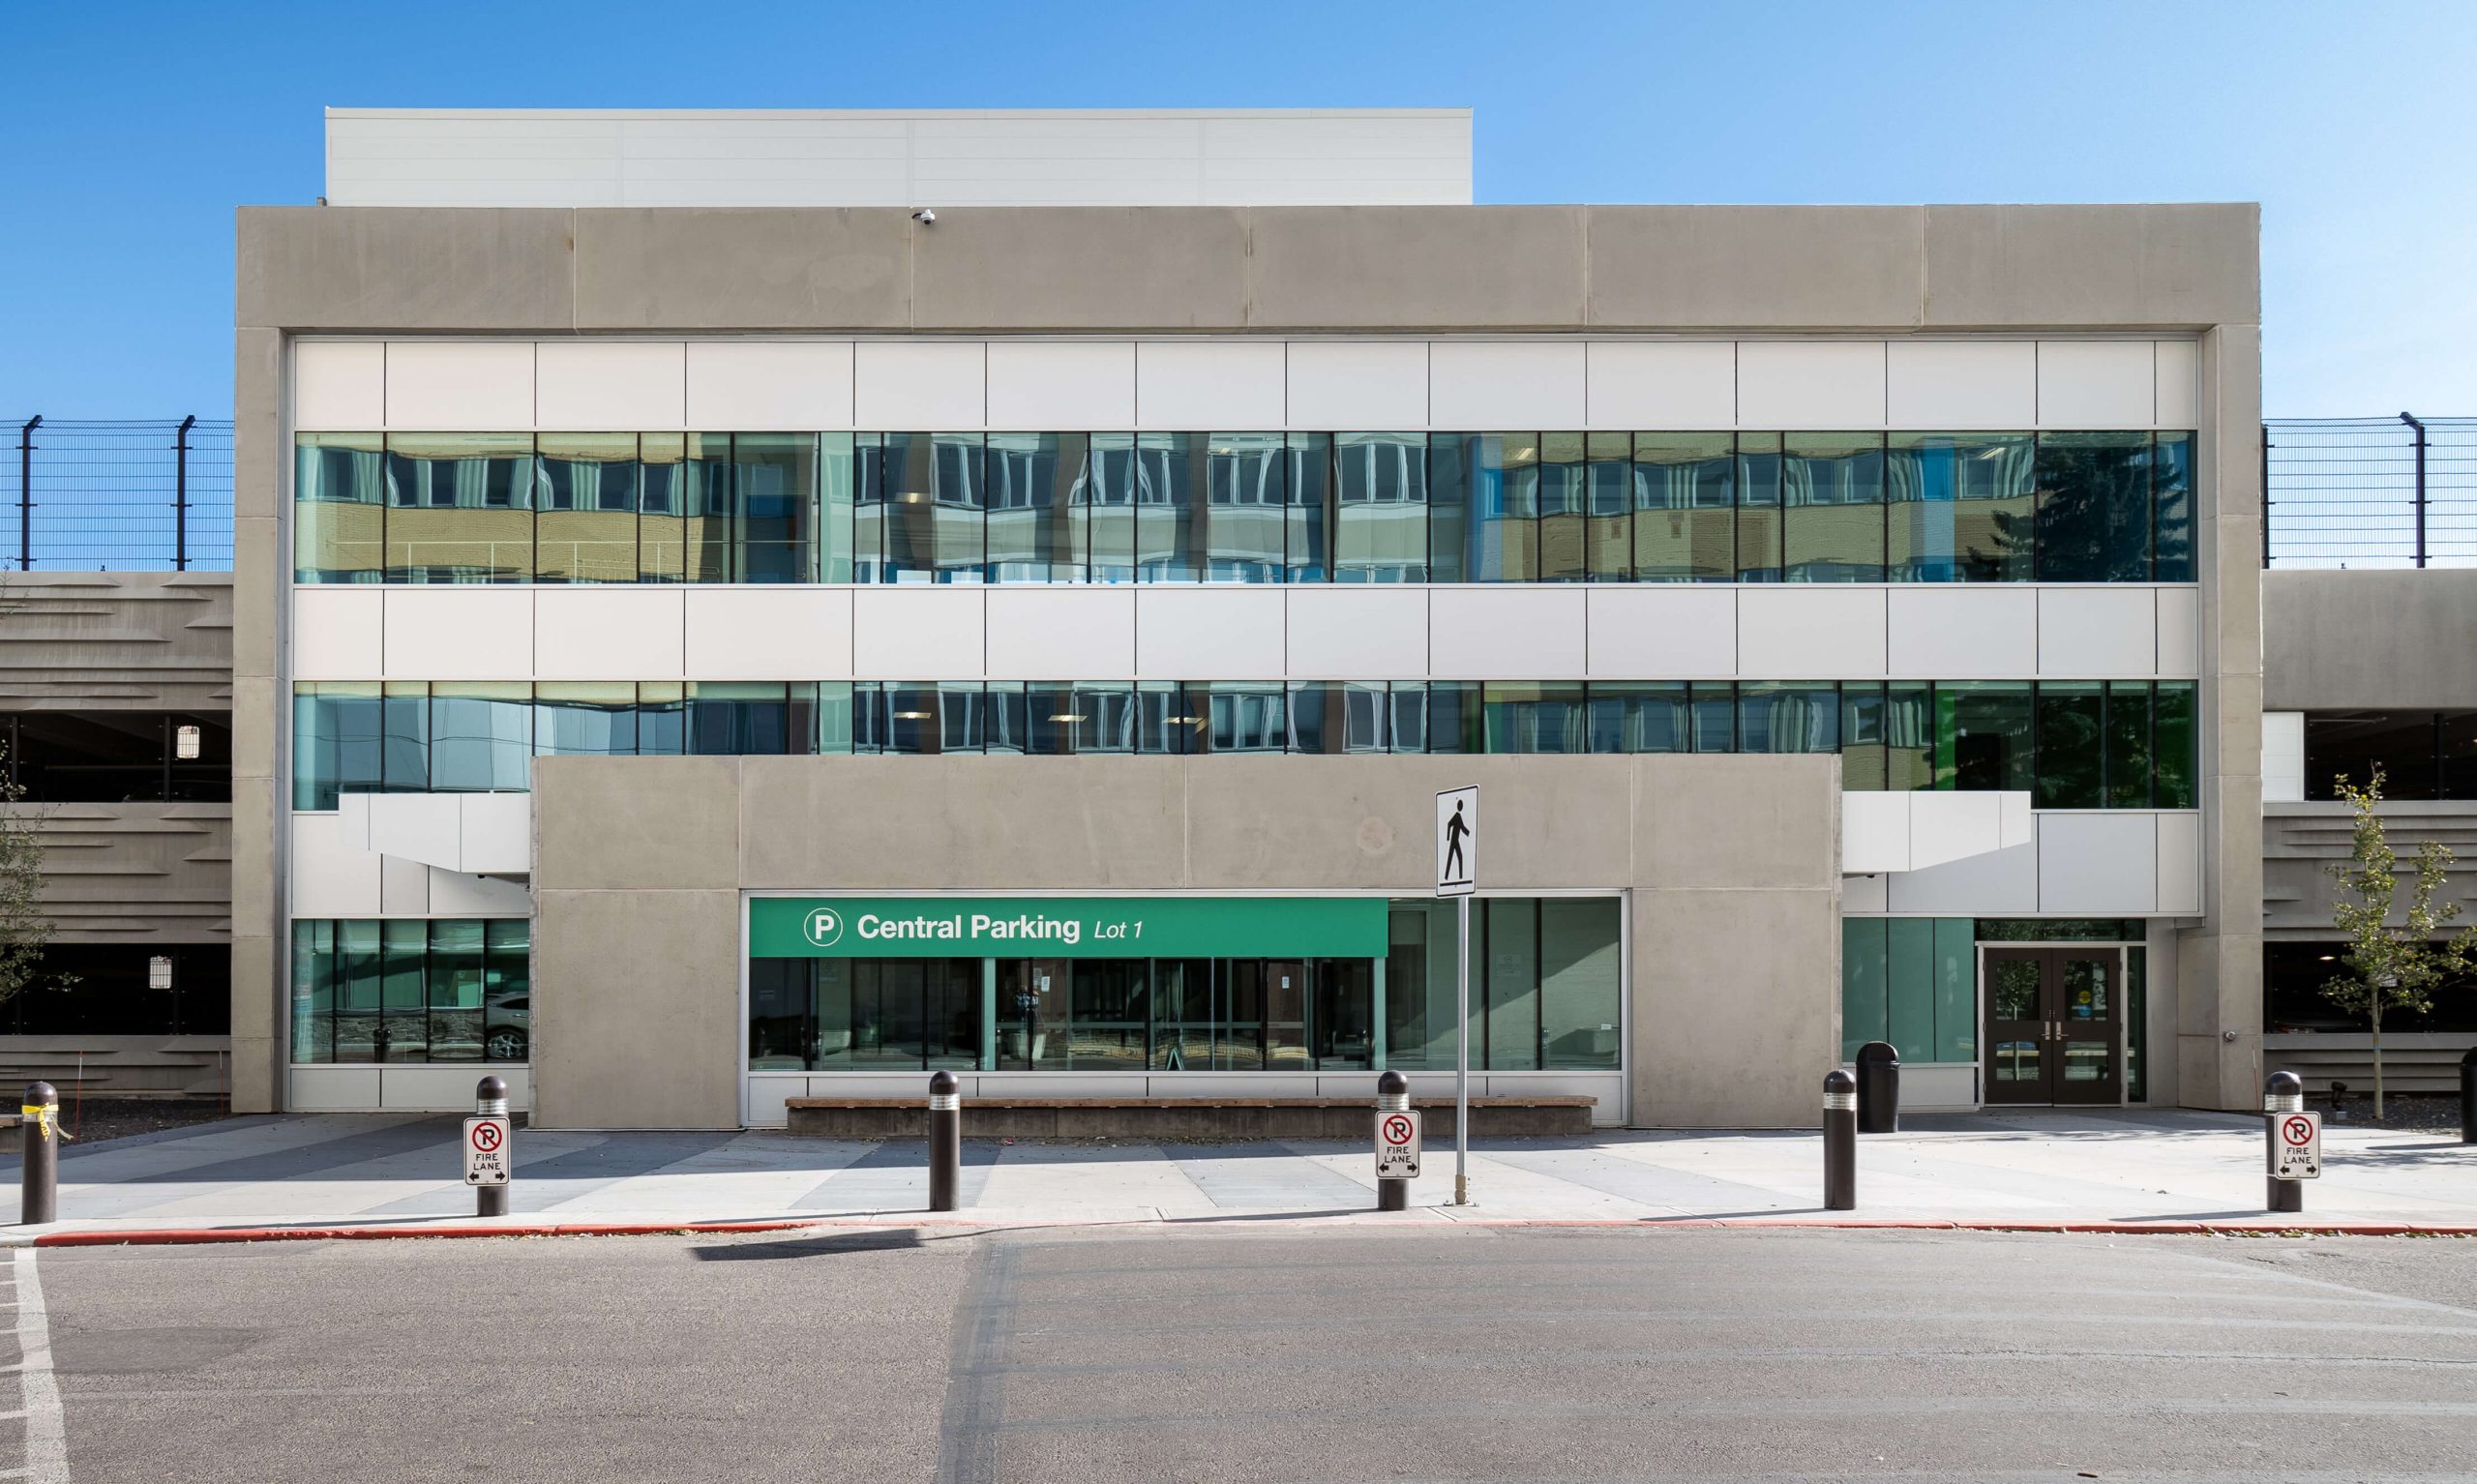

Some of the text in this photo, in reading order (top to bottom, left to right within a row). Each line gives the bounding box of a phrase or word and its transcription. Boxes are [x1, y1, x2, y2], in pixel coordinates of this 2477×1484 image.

[816, 914, 1143, 944] P Central Parking Lot 1
